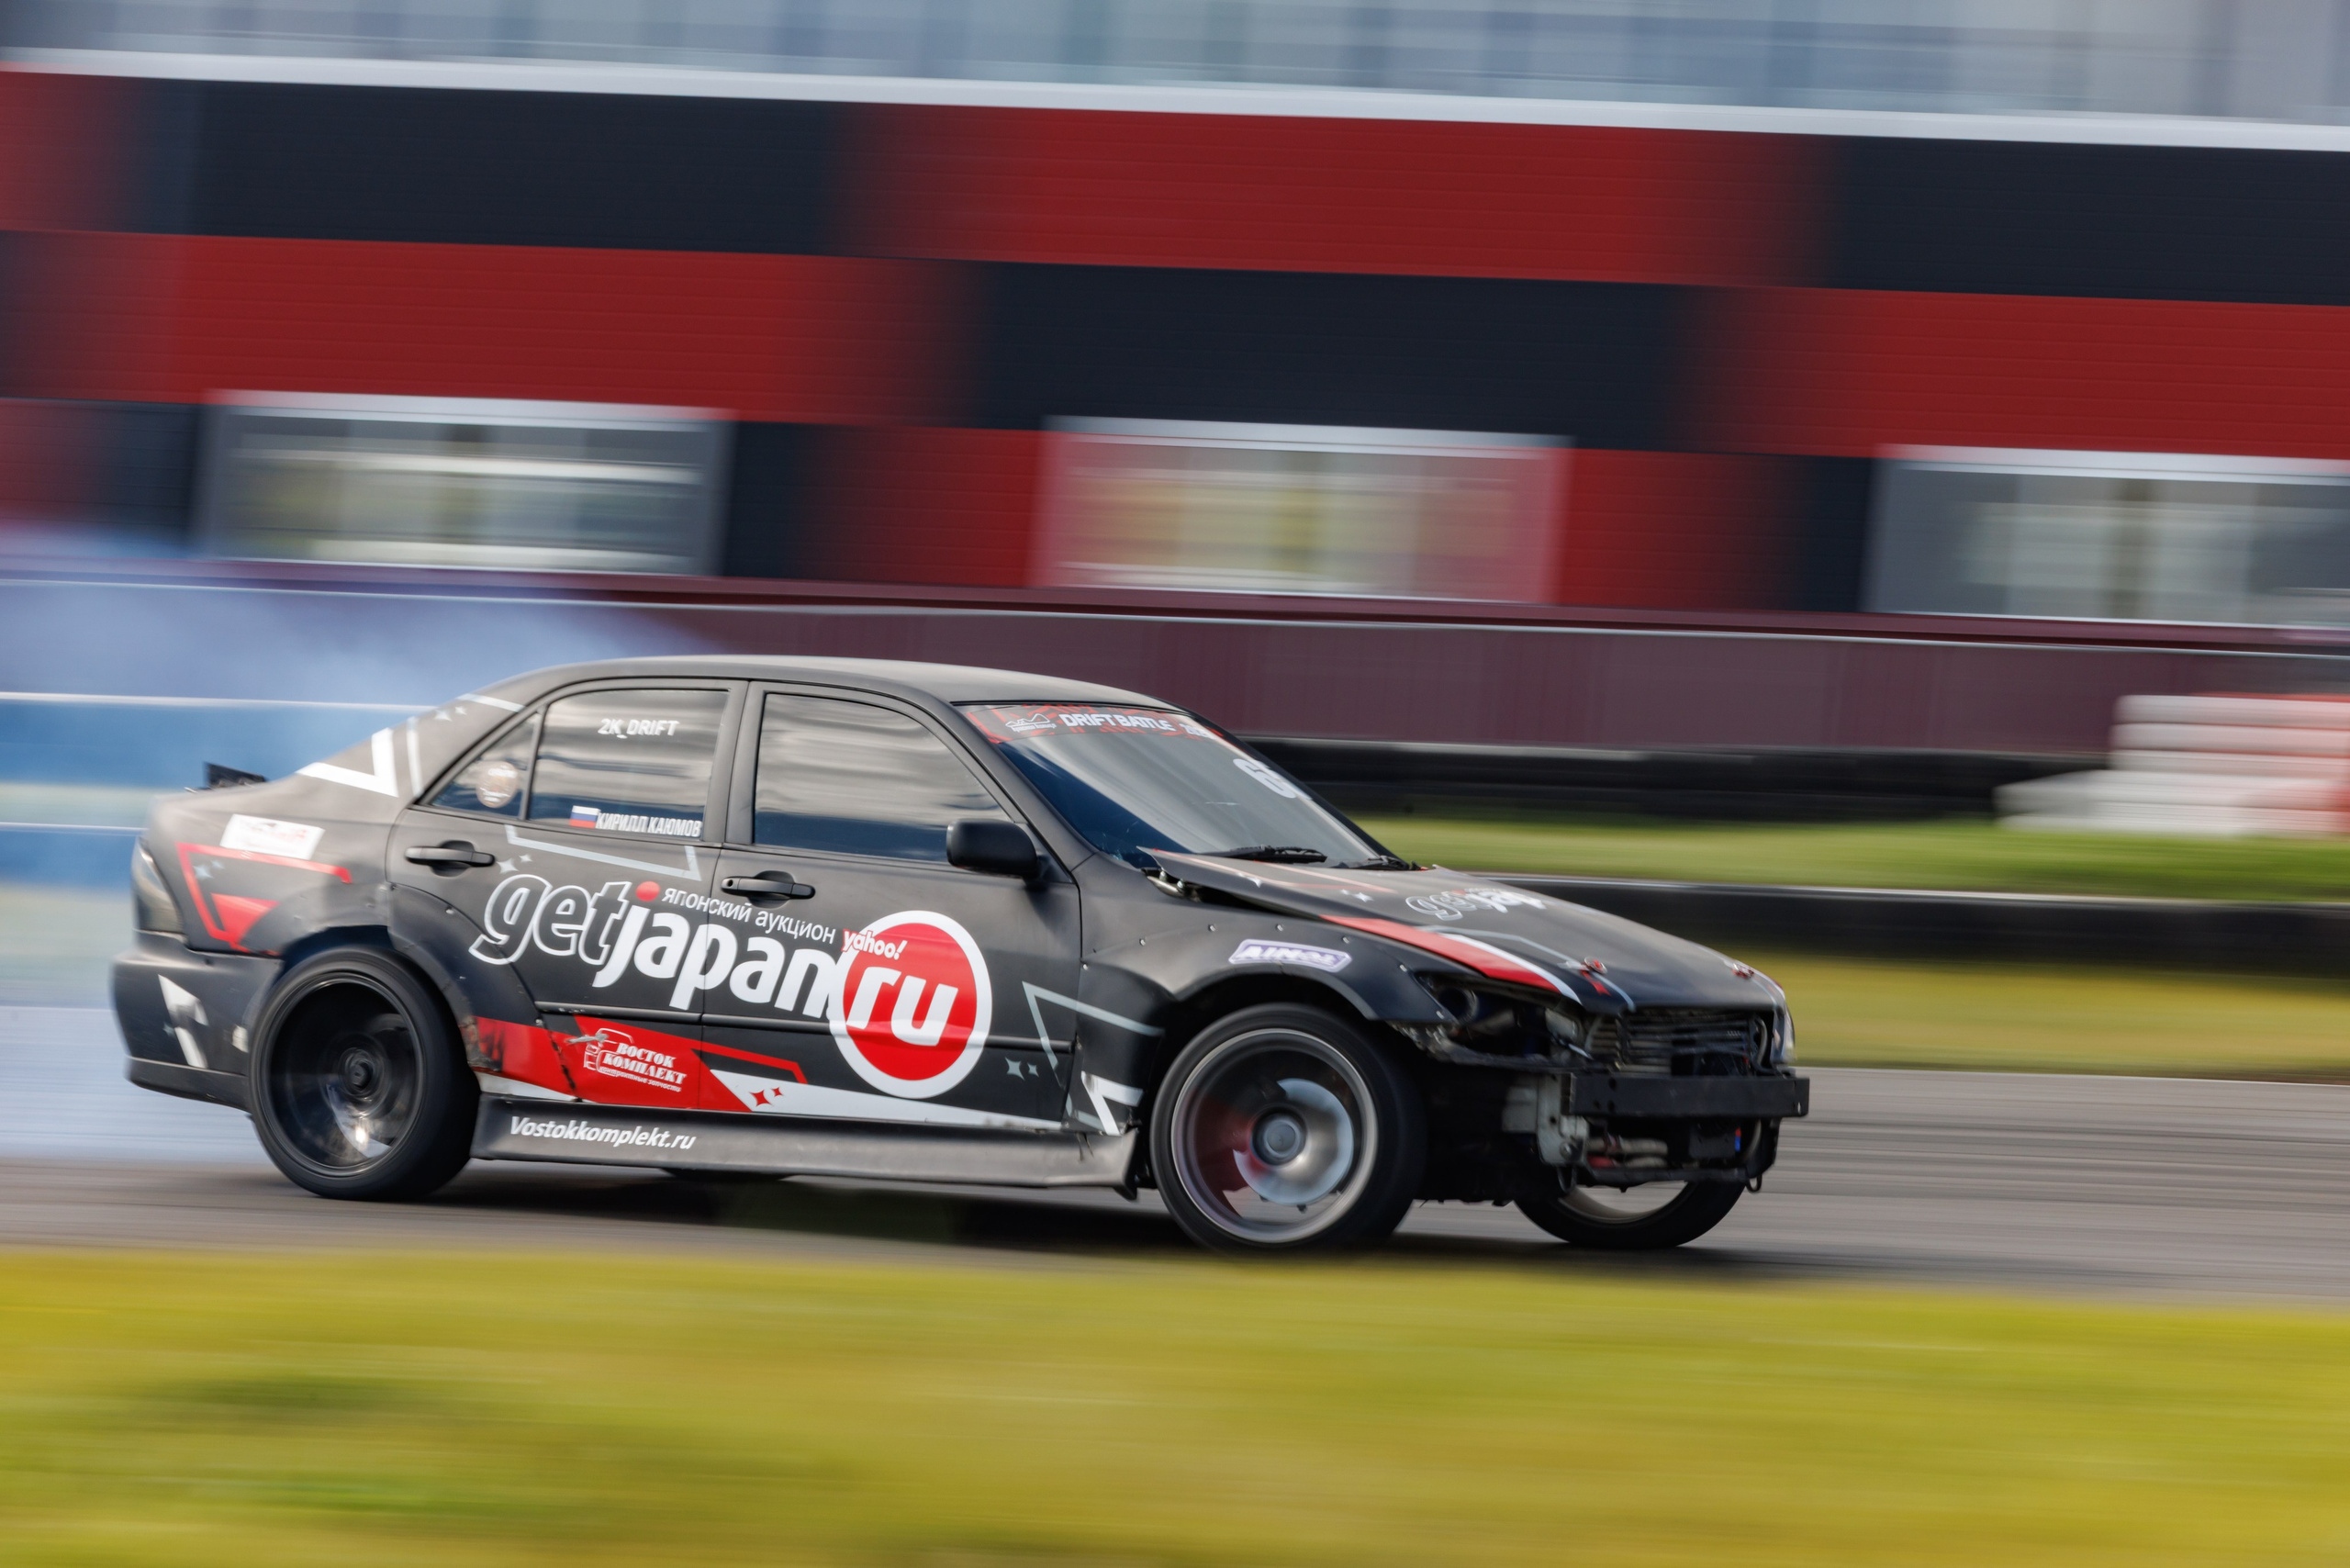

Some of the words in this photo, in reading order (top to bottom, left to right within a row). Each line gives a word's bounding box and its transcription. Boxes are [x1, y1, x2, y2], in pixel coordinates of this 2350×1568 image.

[1058, 713, 1118, 728] DRIFT
[1117, 715, 1177, 732] BATTLE
[595, 812, 649, 834] КИРИЛЛ
[647, 816, 702, 837] КАЮМОВ
[662, 887, 753, 923] японский
[755, 910, 836, 944] аукцион
[842, 929, 908, 960] yahoo!
[602, 1052, 688, 1085] КОМПЛЕКТ
[615, 1042, 677, 1069] ВОСТОК
[510, 1115, 698, 1149] Vostokkomplekt.ru
